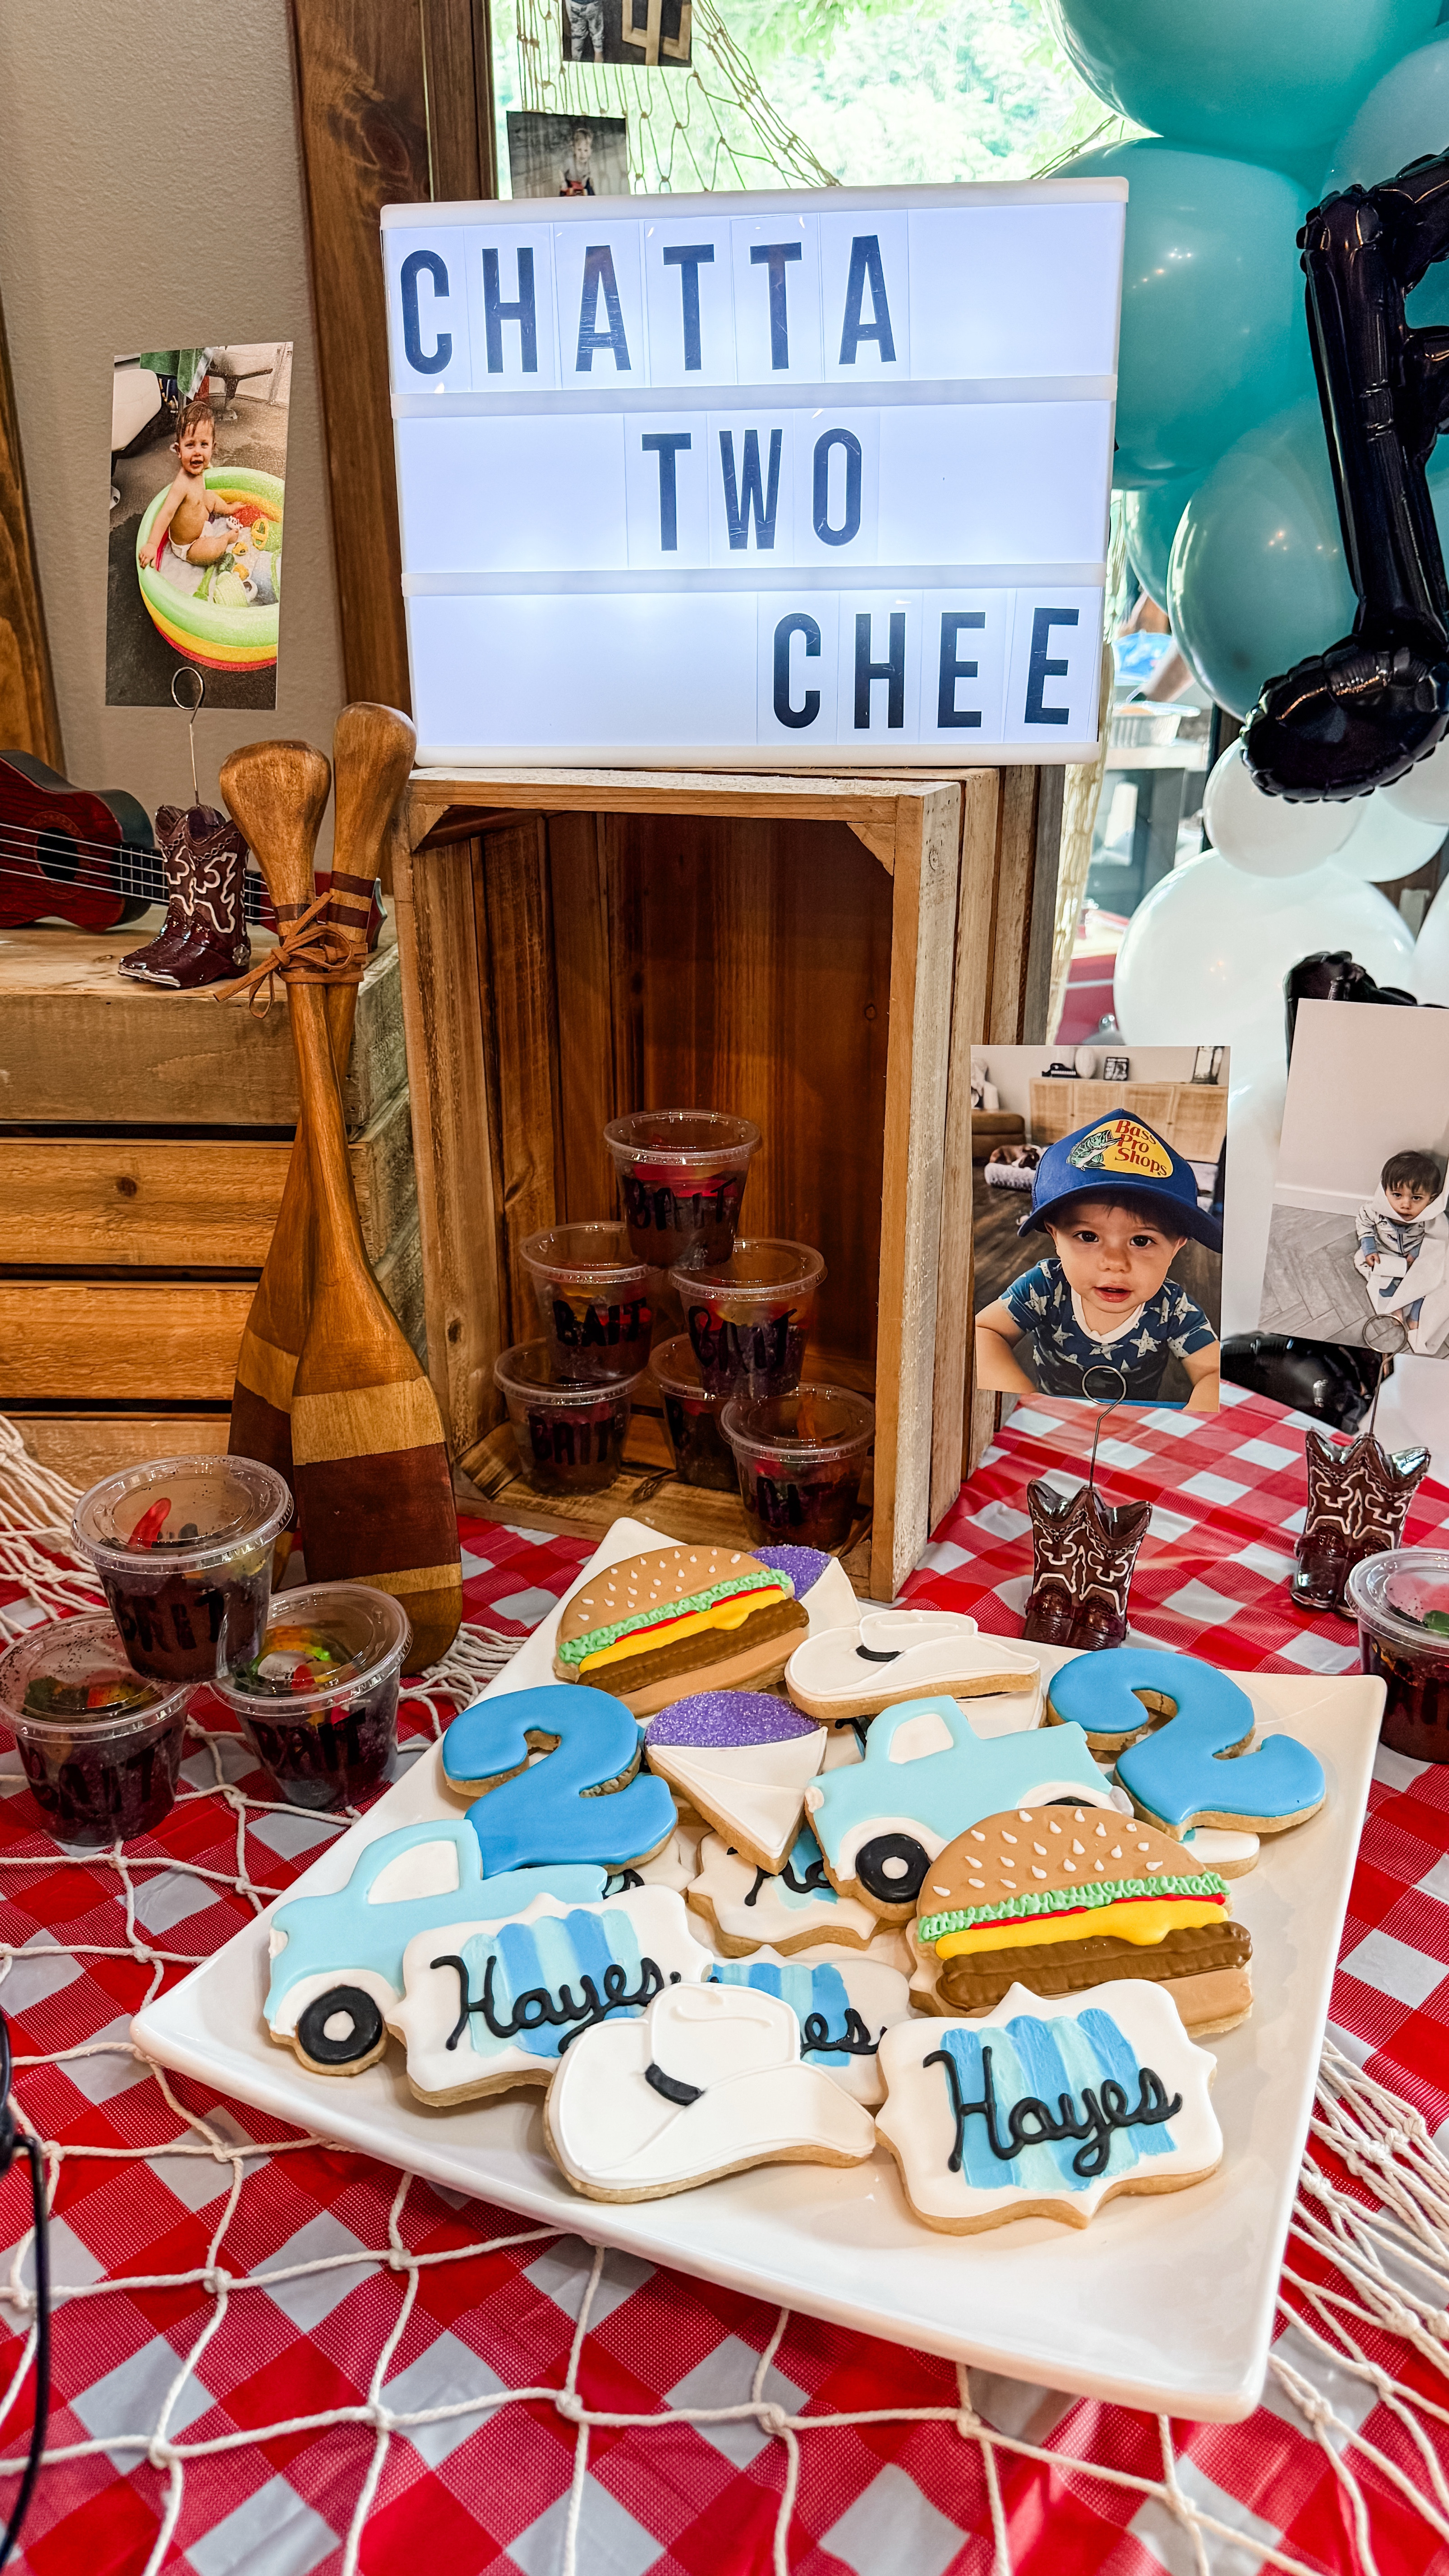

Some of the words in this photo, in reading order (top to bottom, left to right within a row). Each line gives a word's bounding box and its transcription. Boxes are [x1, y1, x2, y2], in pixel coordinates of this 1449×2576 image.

[400, 235, 897, 375] CHATTA
[641, 428, 862, 552] TWO
[772, 607, 1080, 730] CHEE
[1114, 1120, 1156, 1145] Bass
[1114, 1147, 1167, 1176] Shops
[1116, 1134, 1150, 1153] Pro
[622, 1176, 737, 1232] BAIT
[552, 1297, 647, 1347] BAIT
[430, 1954, 681, 2055] Hayes
[923, 2046, 1183, 2178] Hayes
